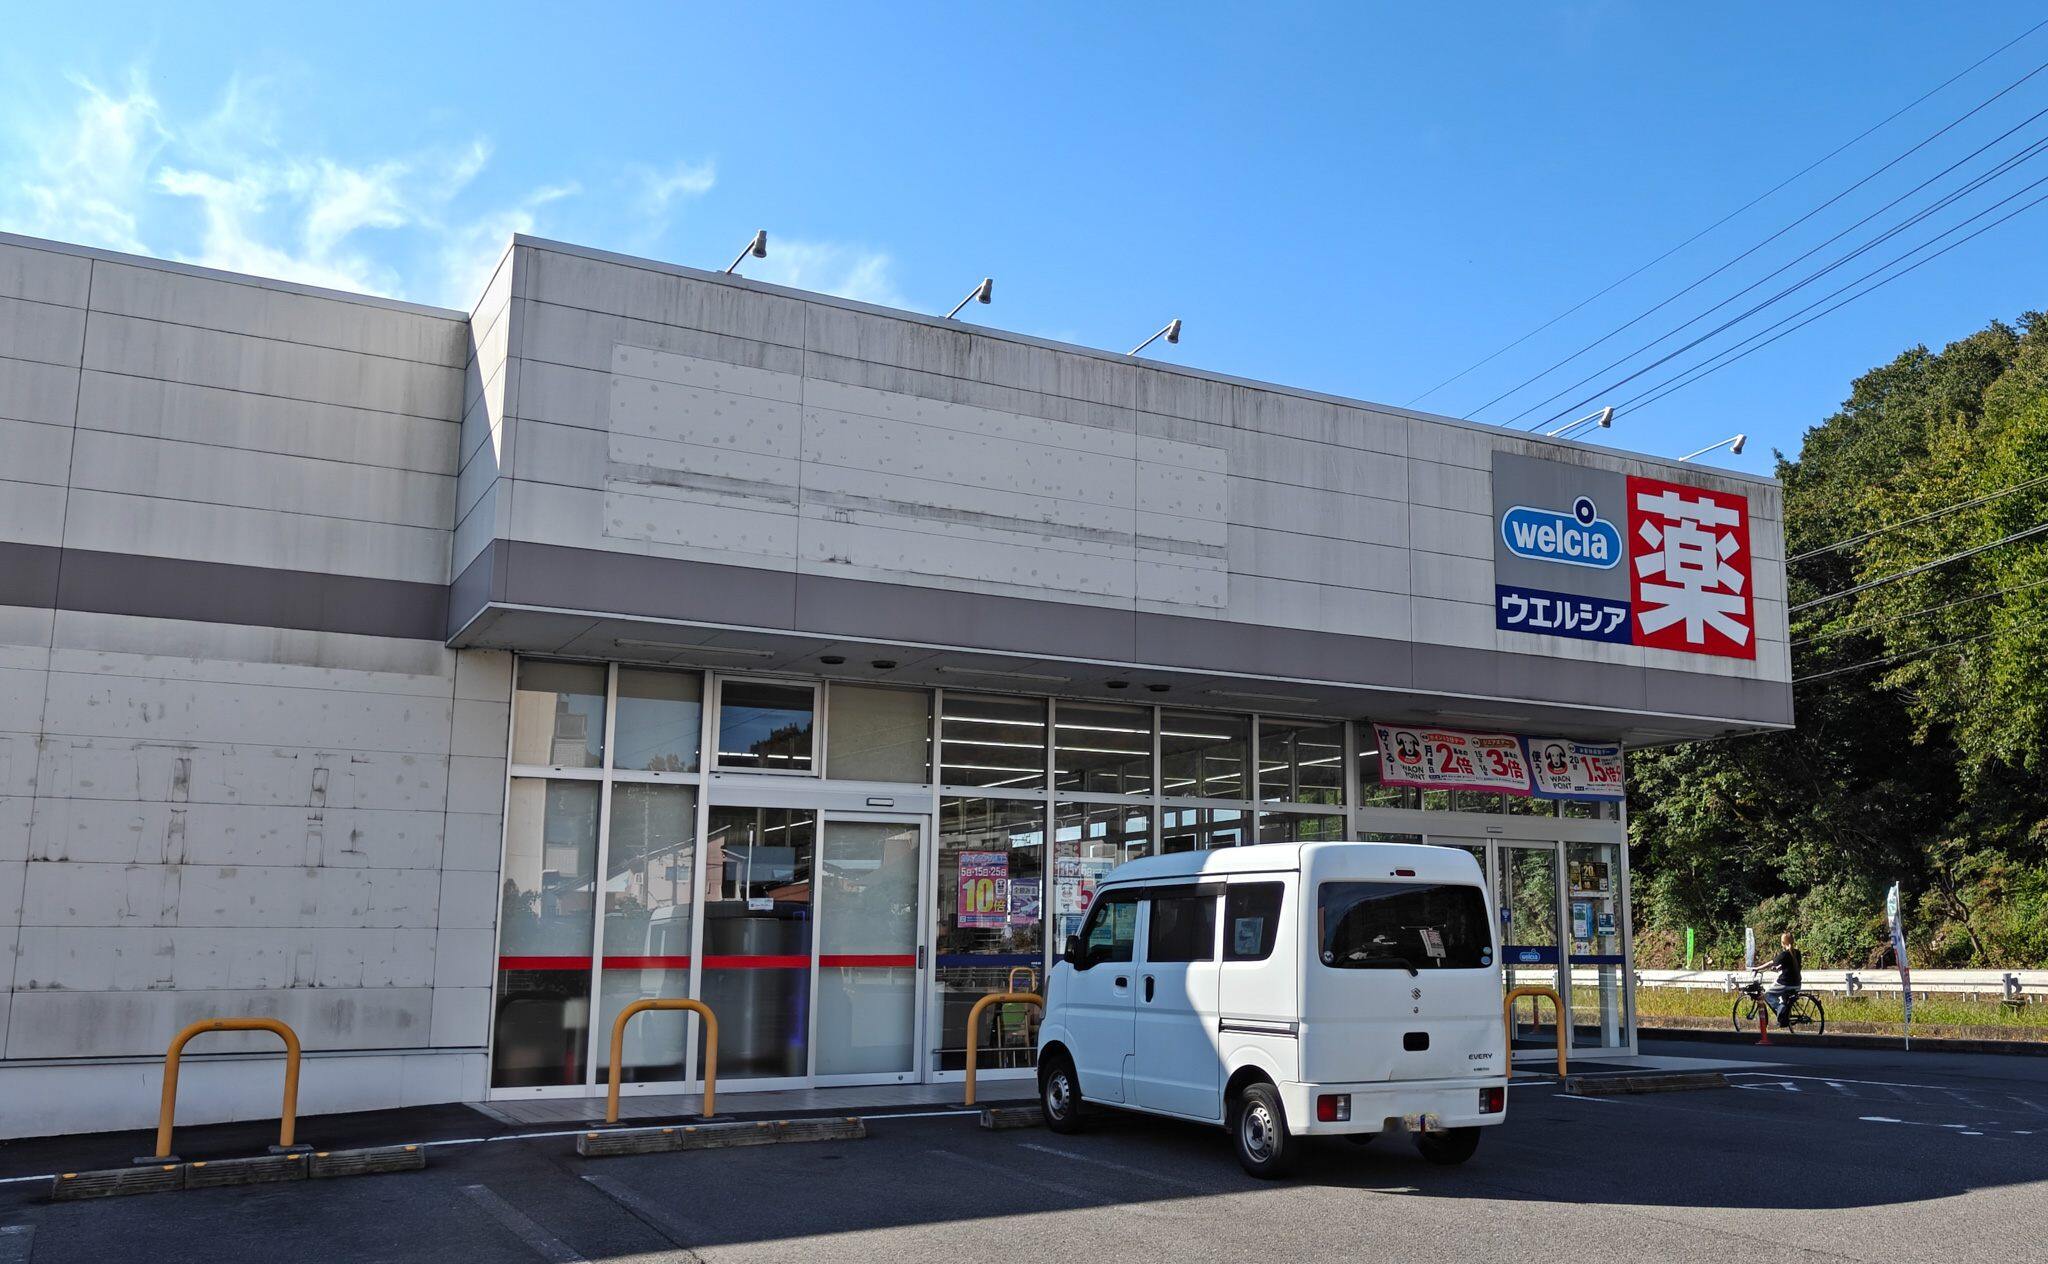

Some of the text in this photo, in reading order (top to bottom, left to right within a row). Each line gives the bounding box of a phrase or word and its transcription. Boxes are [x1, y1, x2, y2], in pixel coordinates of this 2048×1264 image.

[1511, 519, 1609, 560] welcia
[1634, 489, 1751, 647] 薬
[1501, 593, 1627, 635] ウエルシア
[1402, 764, 1425, 774] WAON
[1549, 775, 1571, 783] WAON
